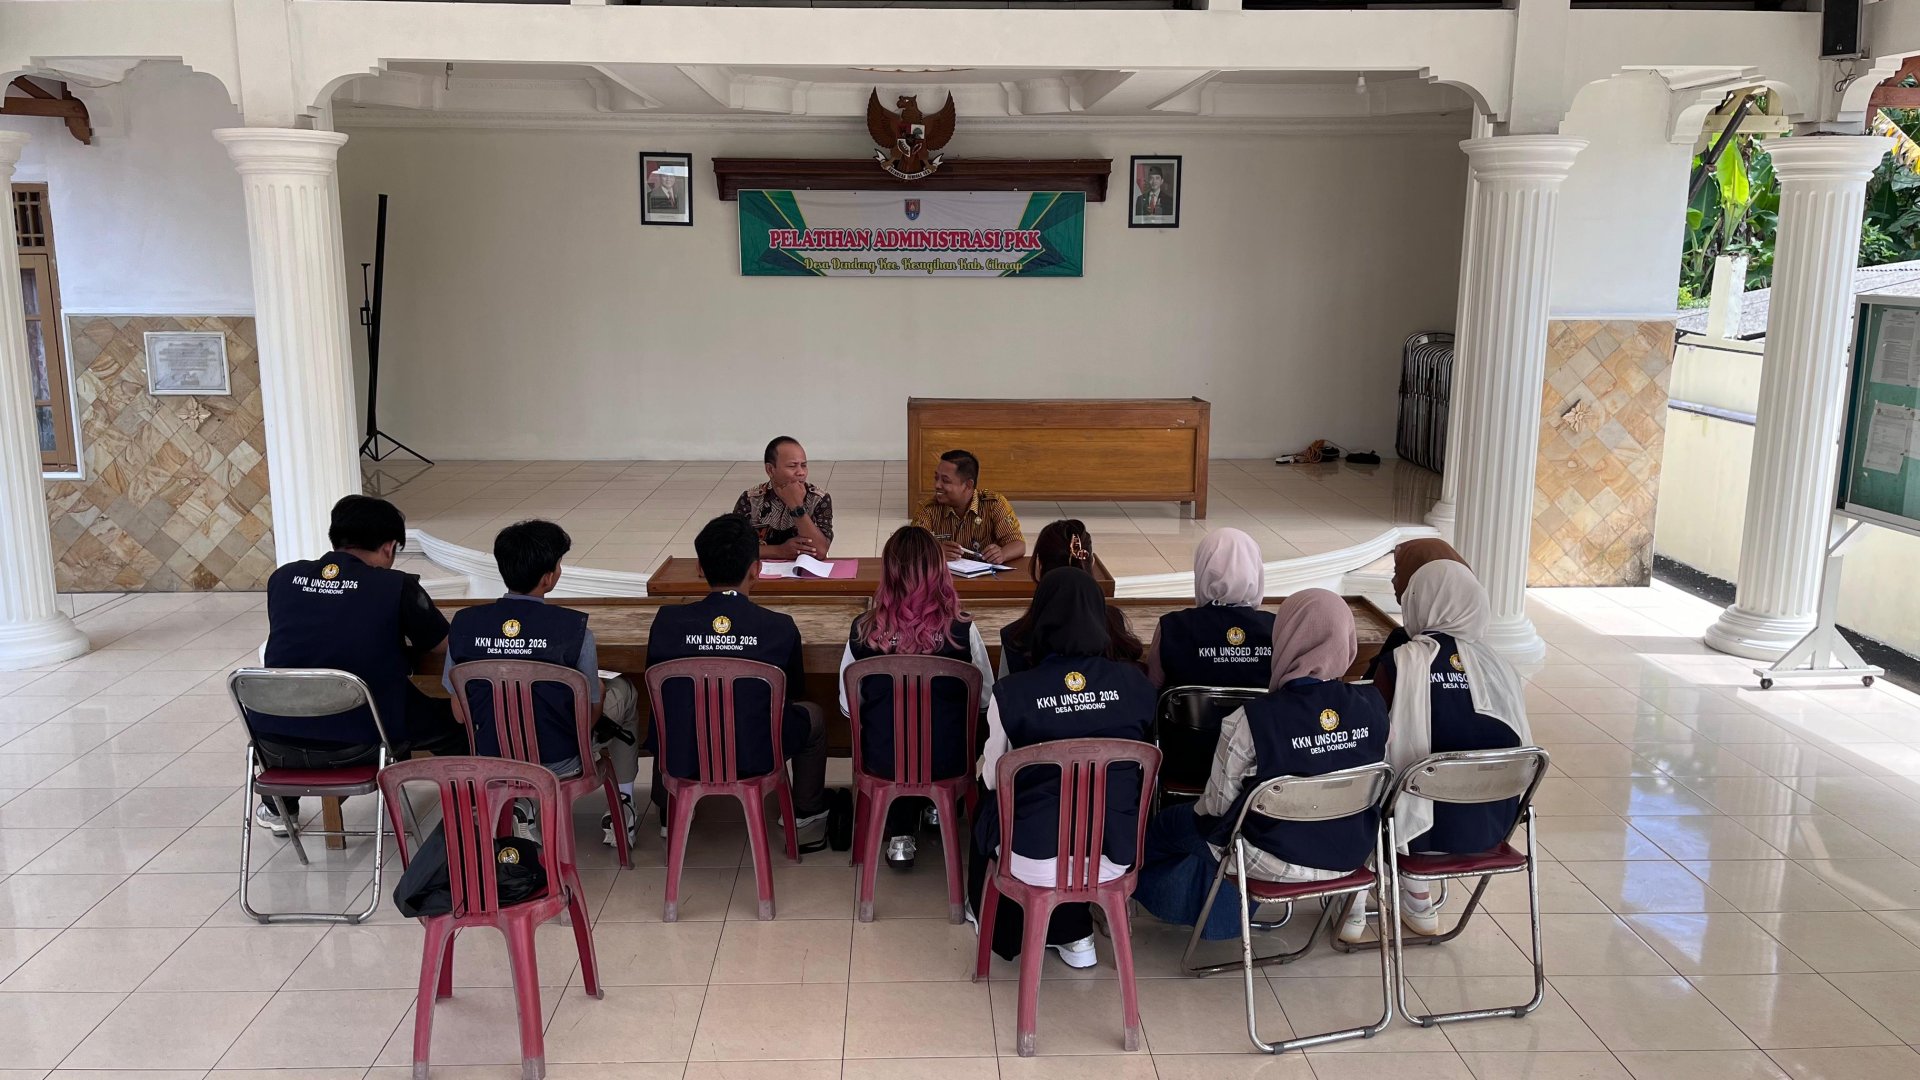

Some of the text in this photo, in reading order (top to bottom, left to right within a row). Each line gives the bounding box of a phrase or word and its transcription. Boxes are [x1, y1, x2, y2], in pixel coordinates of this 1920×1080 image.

[769, 228, 1042, 250] PELATIHAN ADMINISTRASI PKK
[804, 257, 1023, 274] Desa Dondong Kec. Kesugihan Kab. Cilacap
[292, 575, 359, 589] KKN UNSOED 2026
[475, 637, 547, 648] KKN UNSOED 2026
[685, 635, 758, 646] KKN UNSOED 2026
[1198, 646, 1272, 657] KKN UNSOED 2026
[1430, 672, 1445, 682] KN
[1036, 690, 1120, 709] KKN UNSOED 2026
[1055, 702, 1106, 714] DESA DONDONG
[1291, 727, 1369, 749] KKN UNSOED 2026
[1310, 740, 1357, 755] DESA DONDONG
